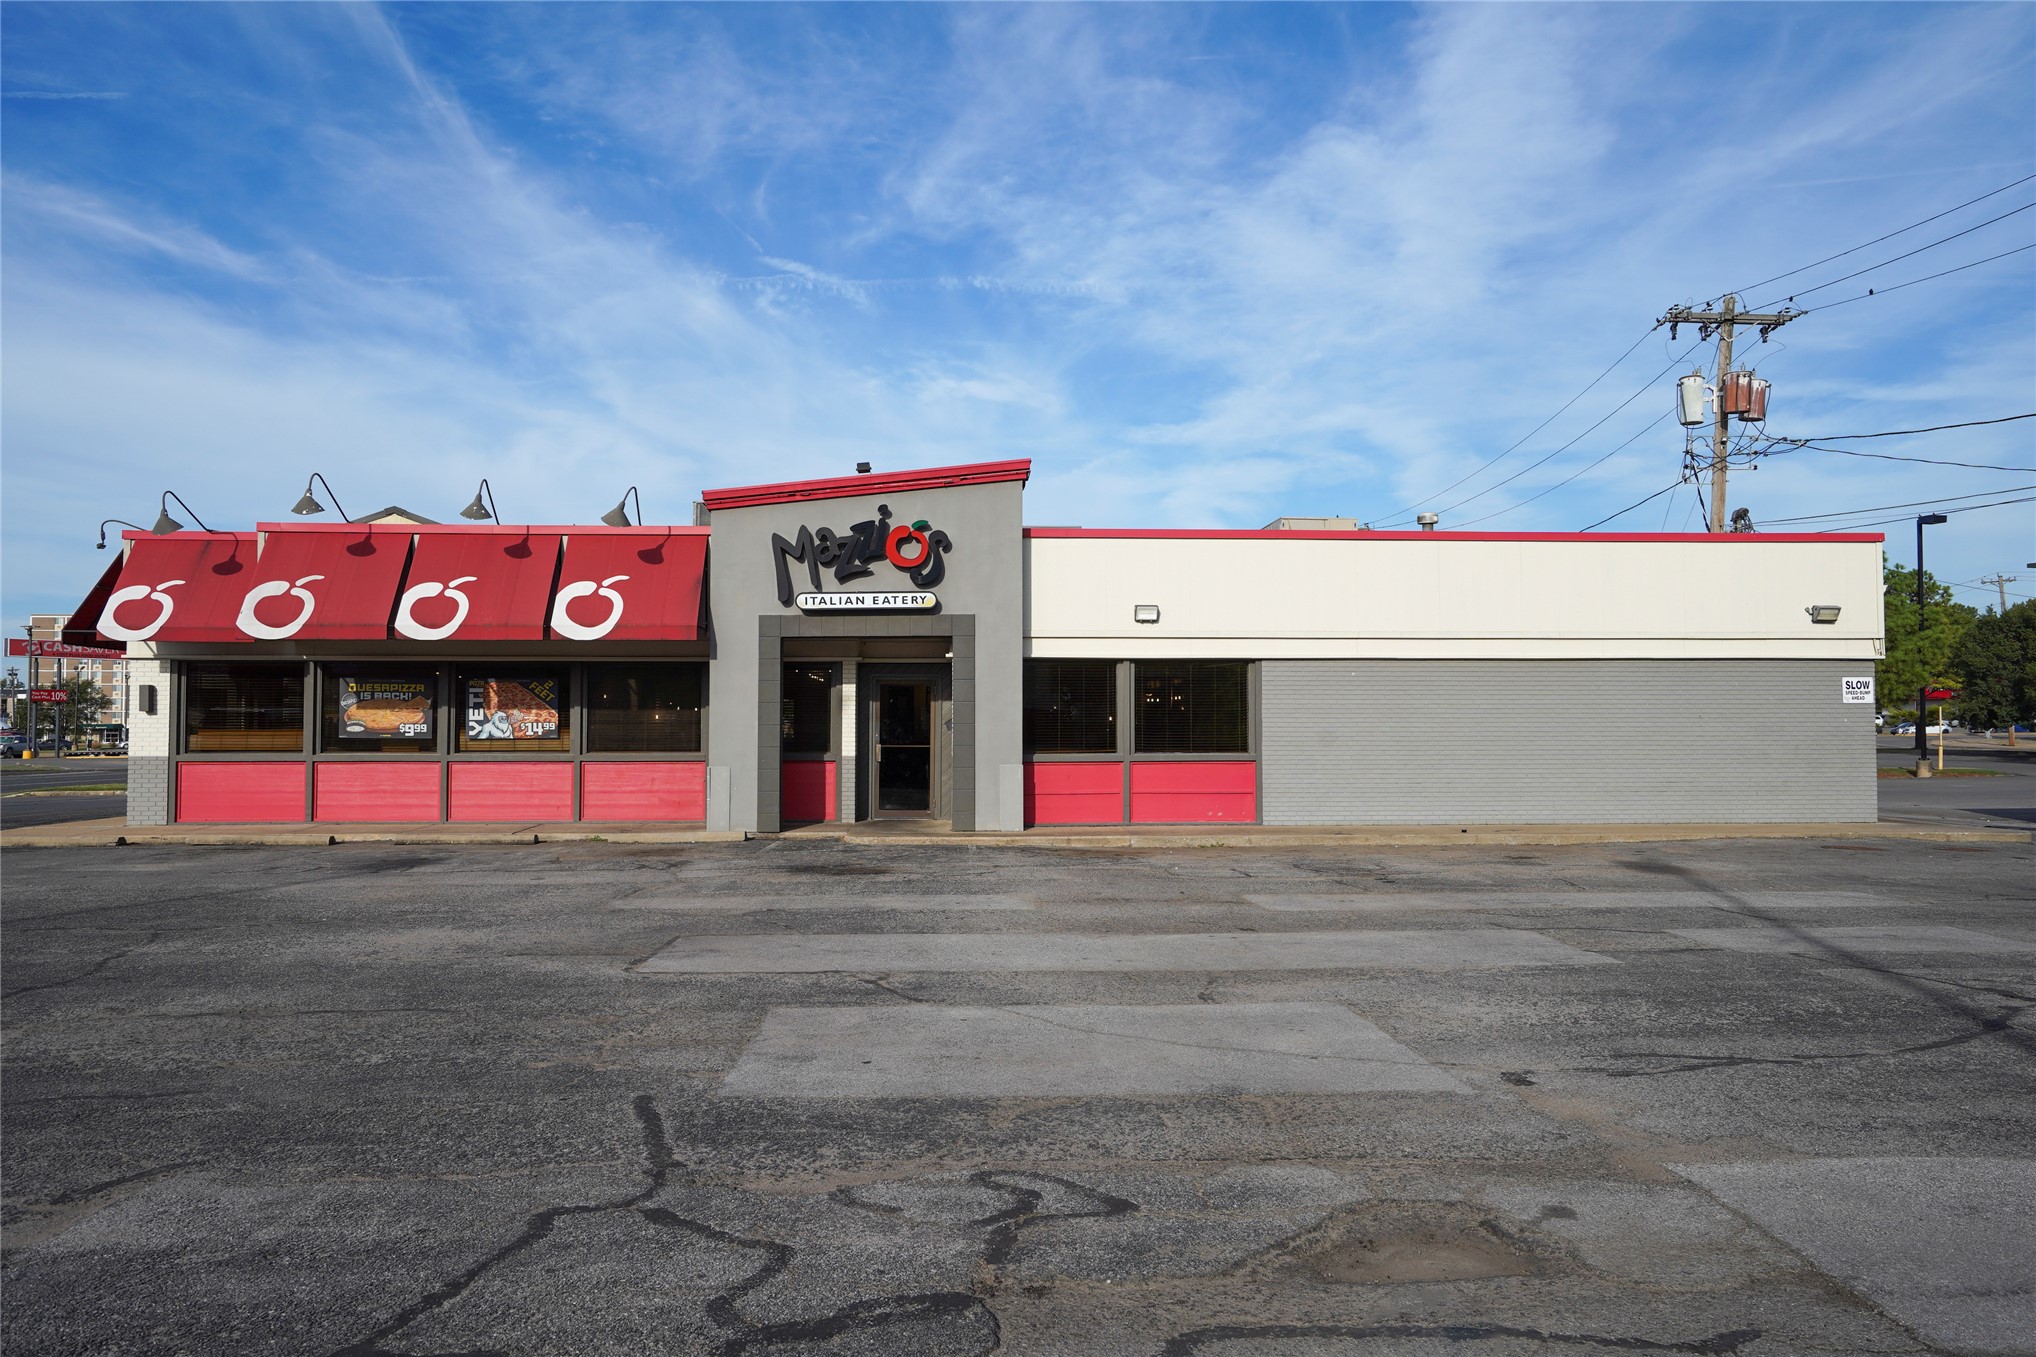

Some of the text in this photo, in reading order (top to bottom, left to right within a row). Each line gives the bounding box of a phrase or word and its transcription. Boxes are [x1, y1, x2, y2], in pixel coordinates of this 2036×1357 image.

[804, 595, 928, 606] ITALIAN EATERY
[348, 683, 425, 692] QUESAPIZZA
[544, 680, 554, 690] 2
[1845, 680, 1870, 690] SLOW
[51, 692, 67, 700] 10%
[360, 692, 412, 700] IS BACK!
[529, 681, 556, 702] FEET
[469, 688, 484, 736] YETI
